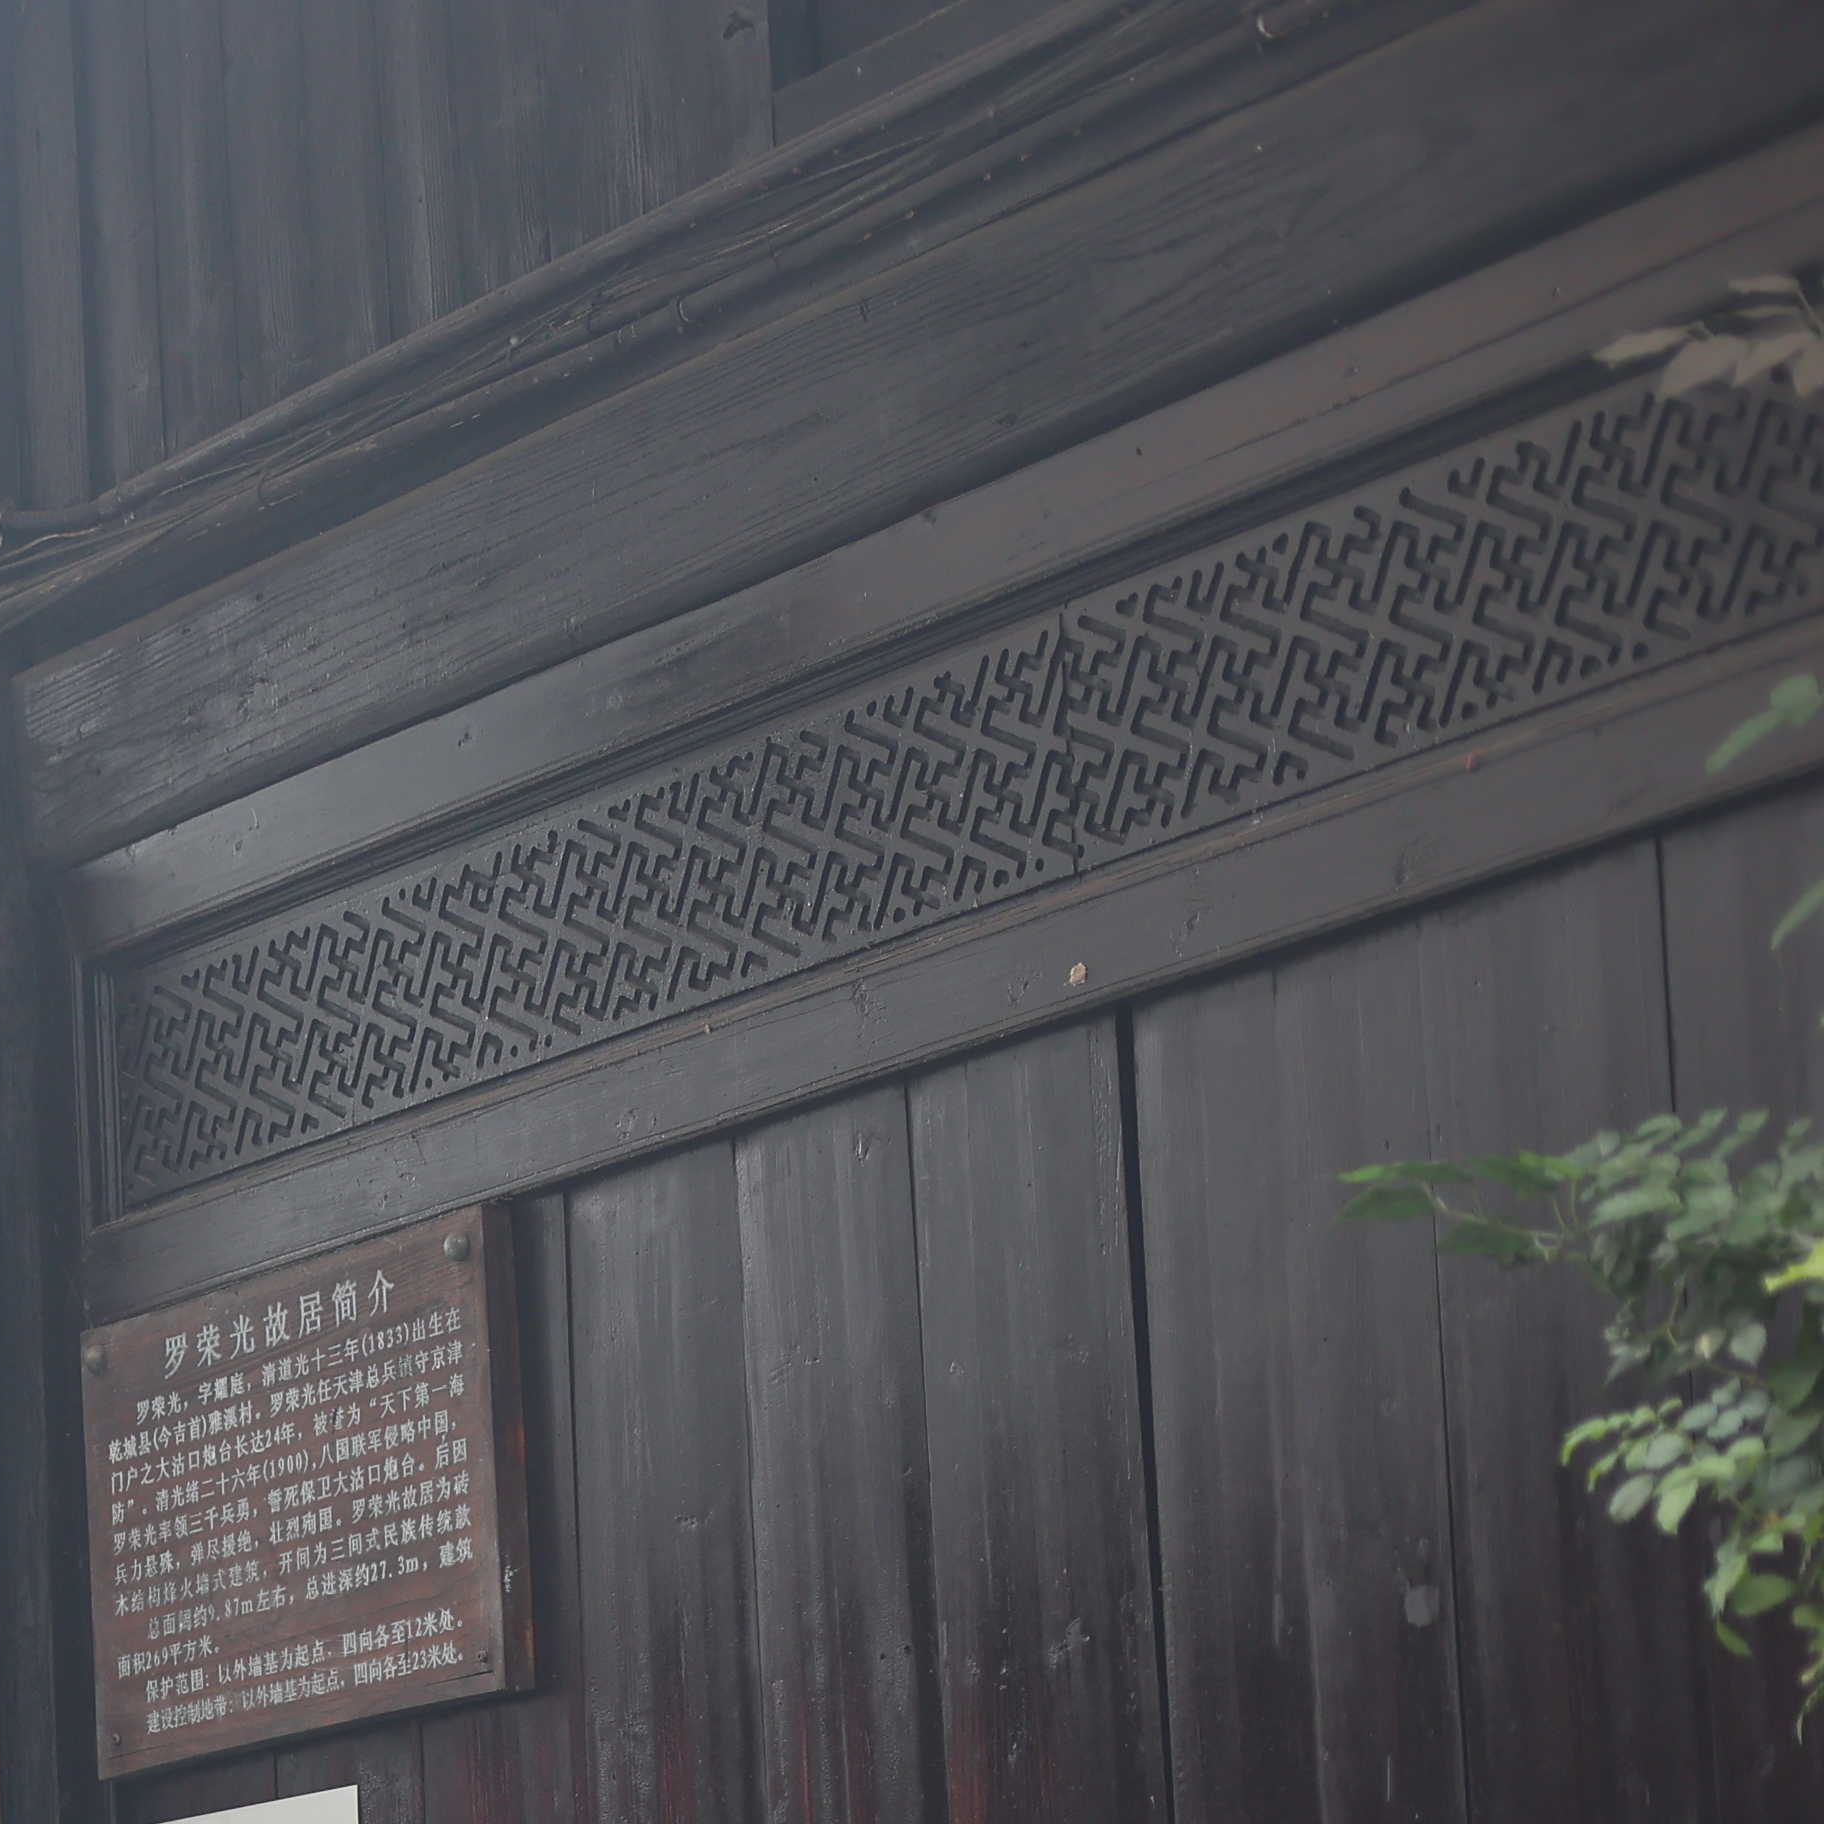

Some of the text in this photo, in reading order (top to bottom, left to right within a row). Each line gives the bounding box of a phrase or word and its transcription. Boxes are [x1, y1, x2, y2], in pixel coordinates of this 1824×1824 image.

[164, 1269, 394, 1380] 罗荣光故居简介
